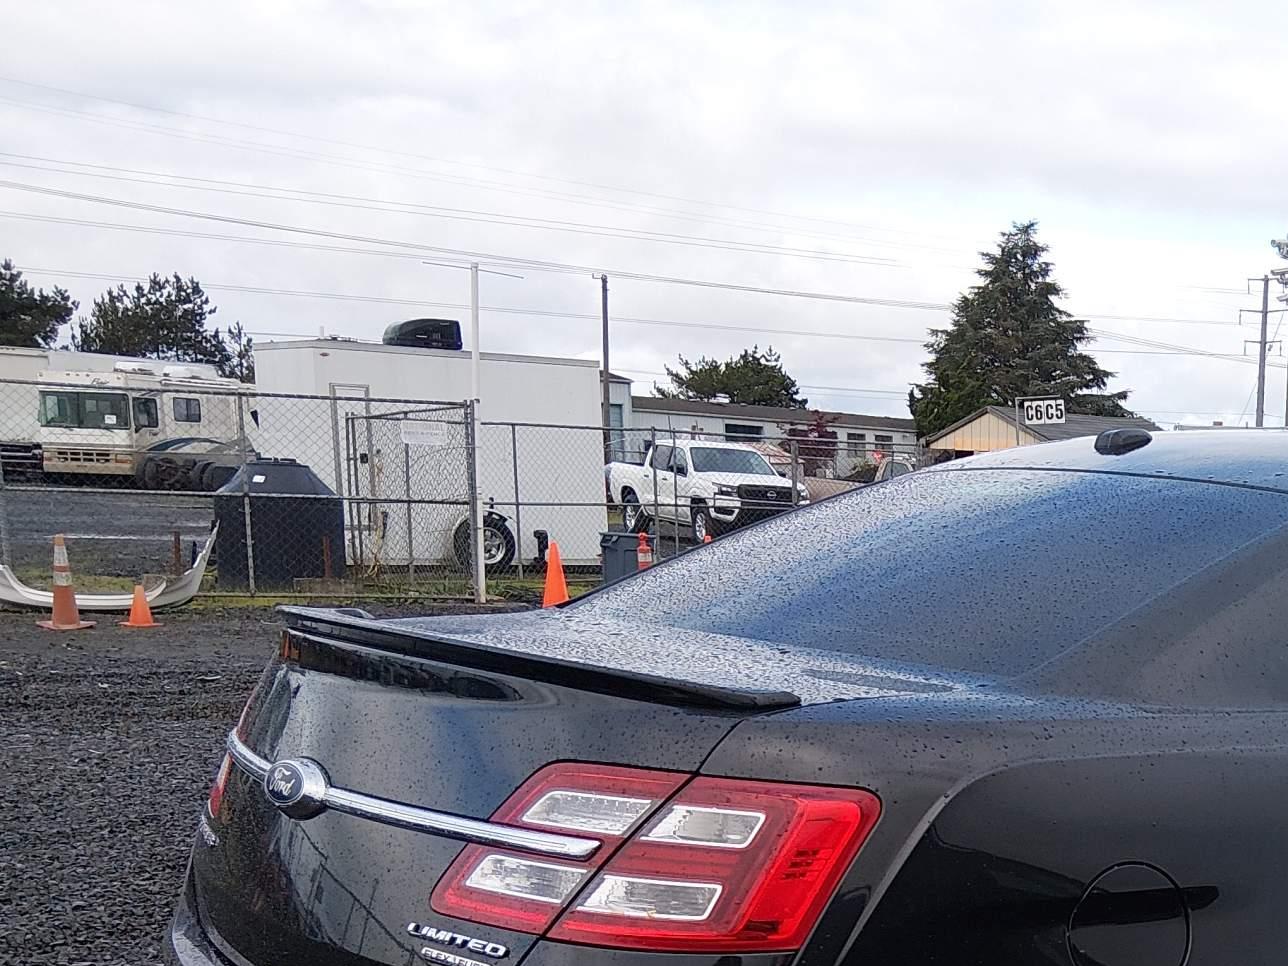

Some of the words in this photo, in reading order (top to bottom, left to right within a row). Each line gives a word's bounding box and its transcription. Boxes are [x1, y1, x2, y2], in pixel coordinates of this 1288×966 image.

[1025, 404, 1044, 421] C6
[1045, 403, 1064, 420] C5
[269, 767, 296, 796] Ford
[406, 922, 508, 957] LIMITED
